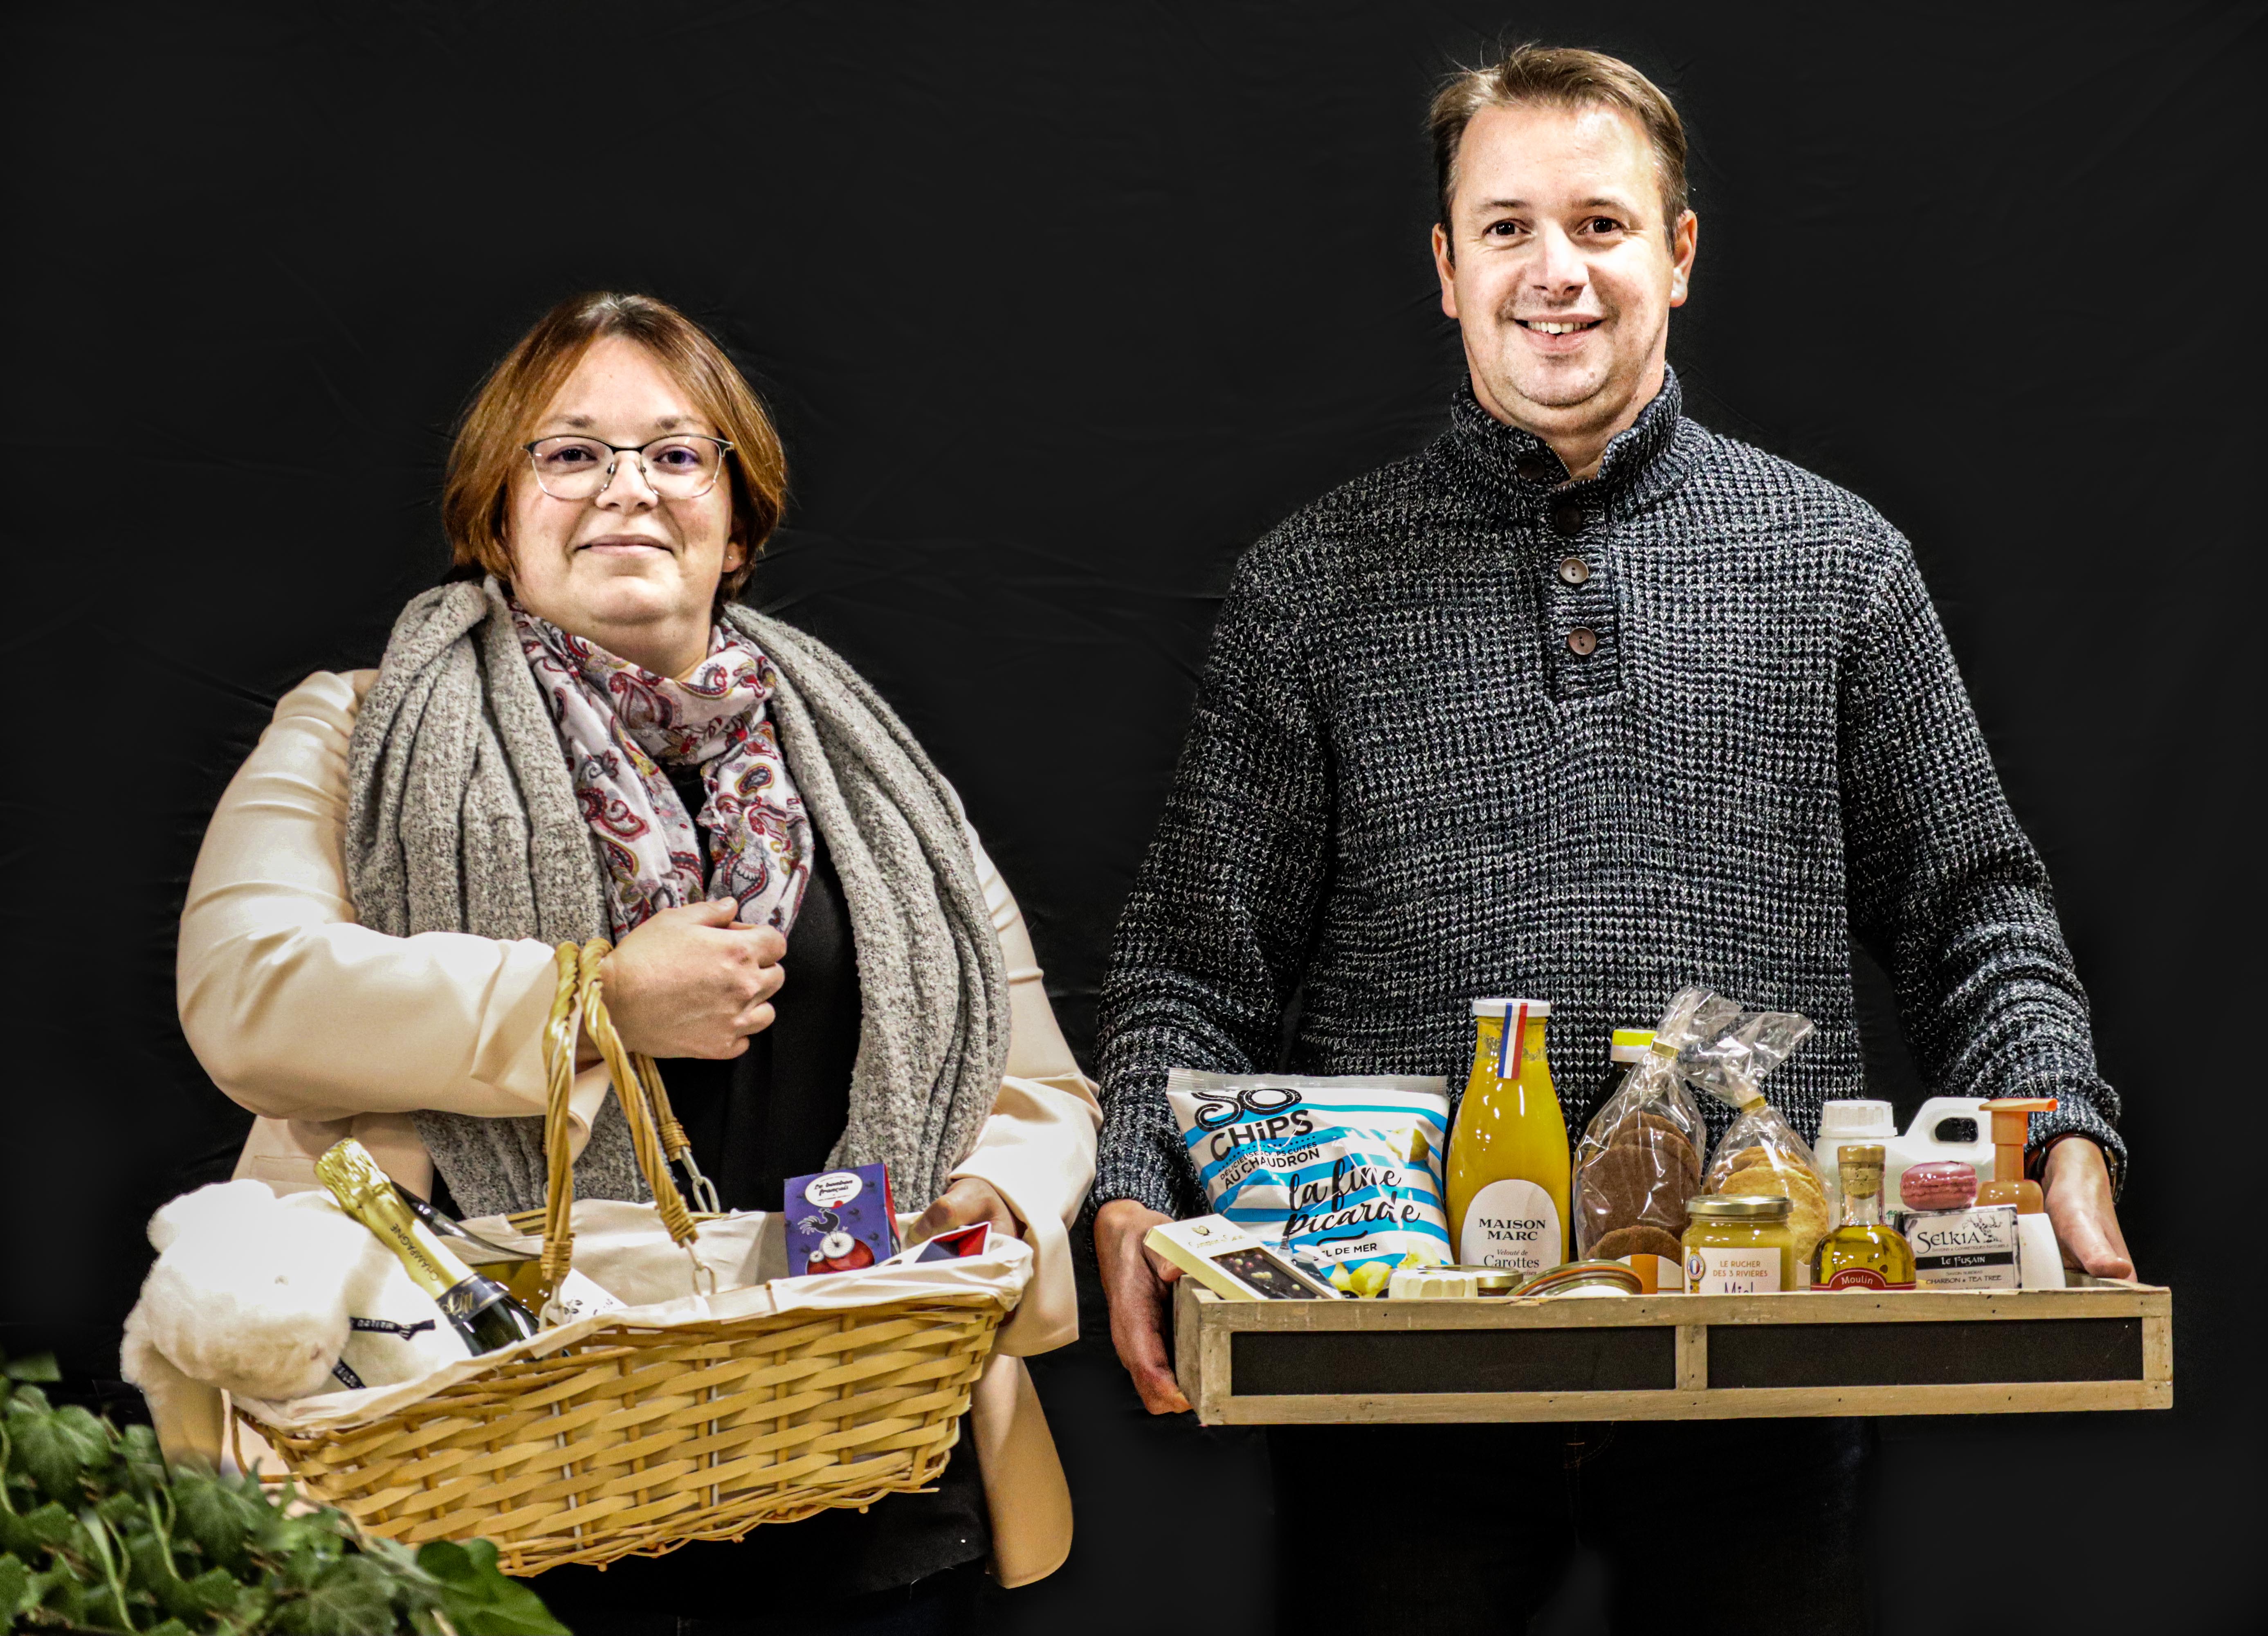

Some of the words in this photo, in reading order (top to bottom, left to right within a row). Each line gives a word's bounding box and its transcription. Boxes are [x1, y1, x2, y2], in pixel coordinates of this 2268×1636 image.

[1288, 1142, 1317, 1155] CUITES
[1225, 1170, 1241, 1190] AU
[1241, 1148, 1320, 1174] CHAUDRON
[1289, 1173, 1327, 1211] la
[1332, 1158, 1401, 1213] fine
[1282, 1191, 1420, 1238] picarde
[1479, 1218, 1546, 1229] MAISON
[1487, 1230, 1538, 1241] MARC
[390, 1223, 438, 1281] CHAMPAGNE
[1354, 1243, 1377, 1252] MER
[1484, 1254, 1540, 1268] Carottes
[1841, 1275, 1873, 1285] Moulin
[1725, 1281, 1753, 1293] Mil
